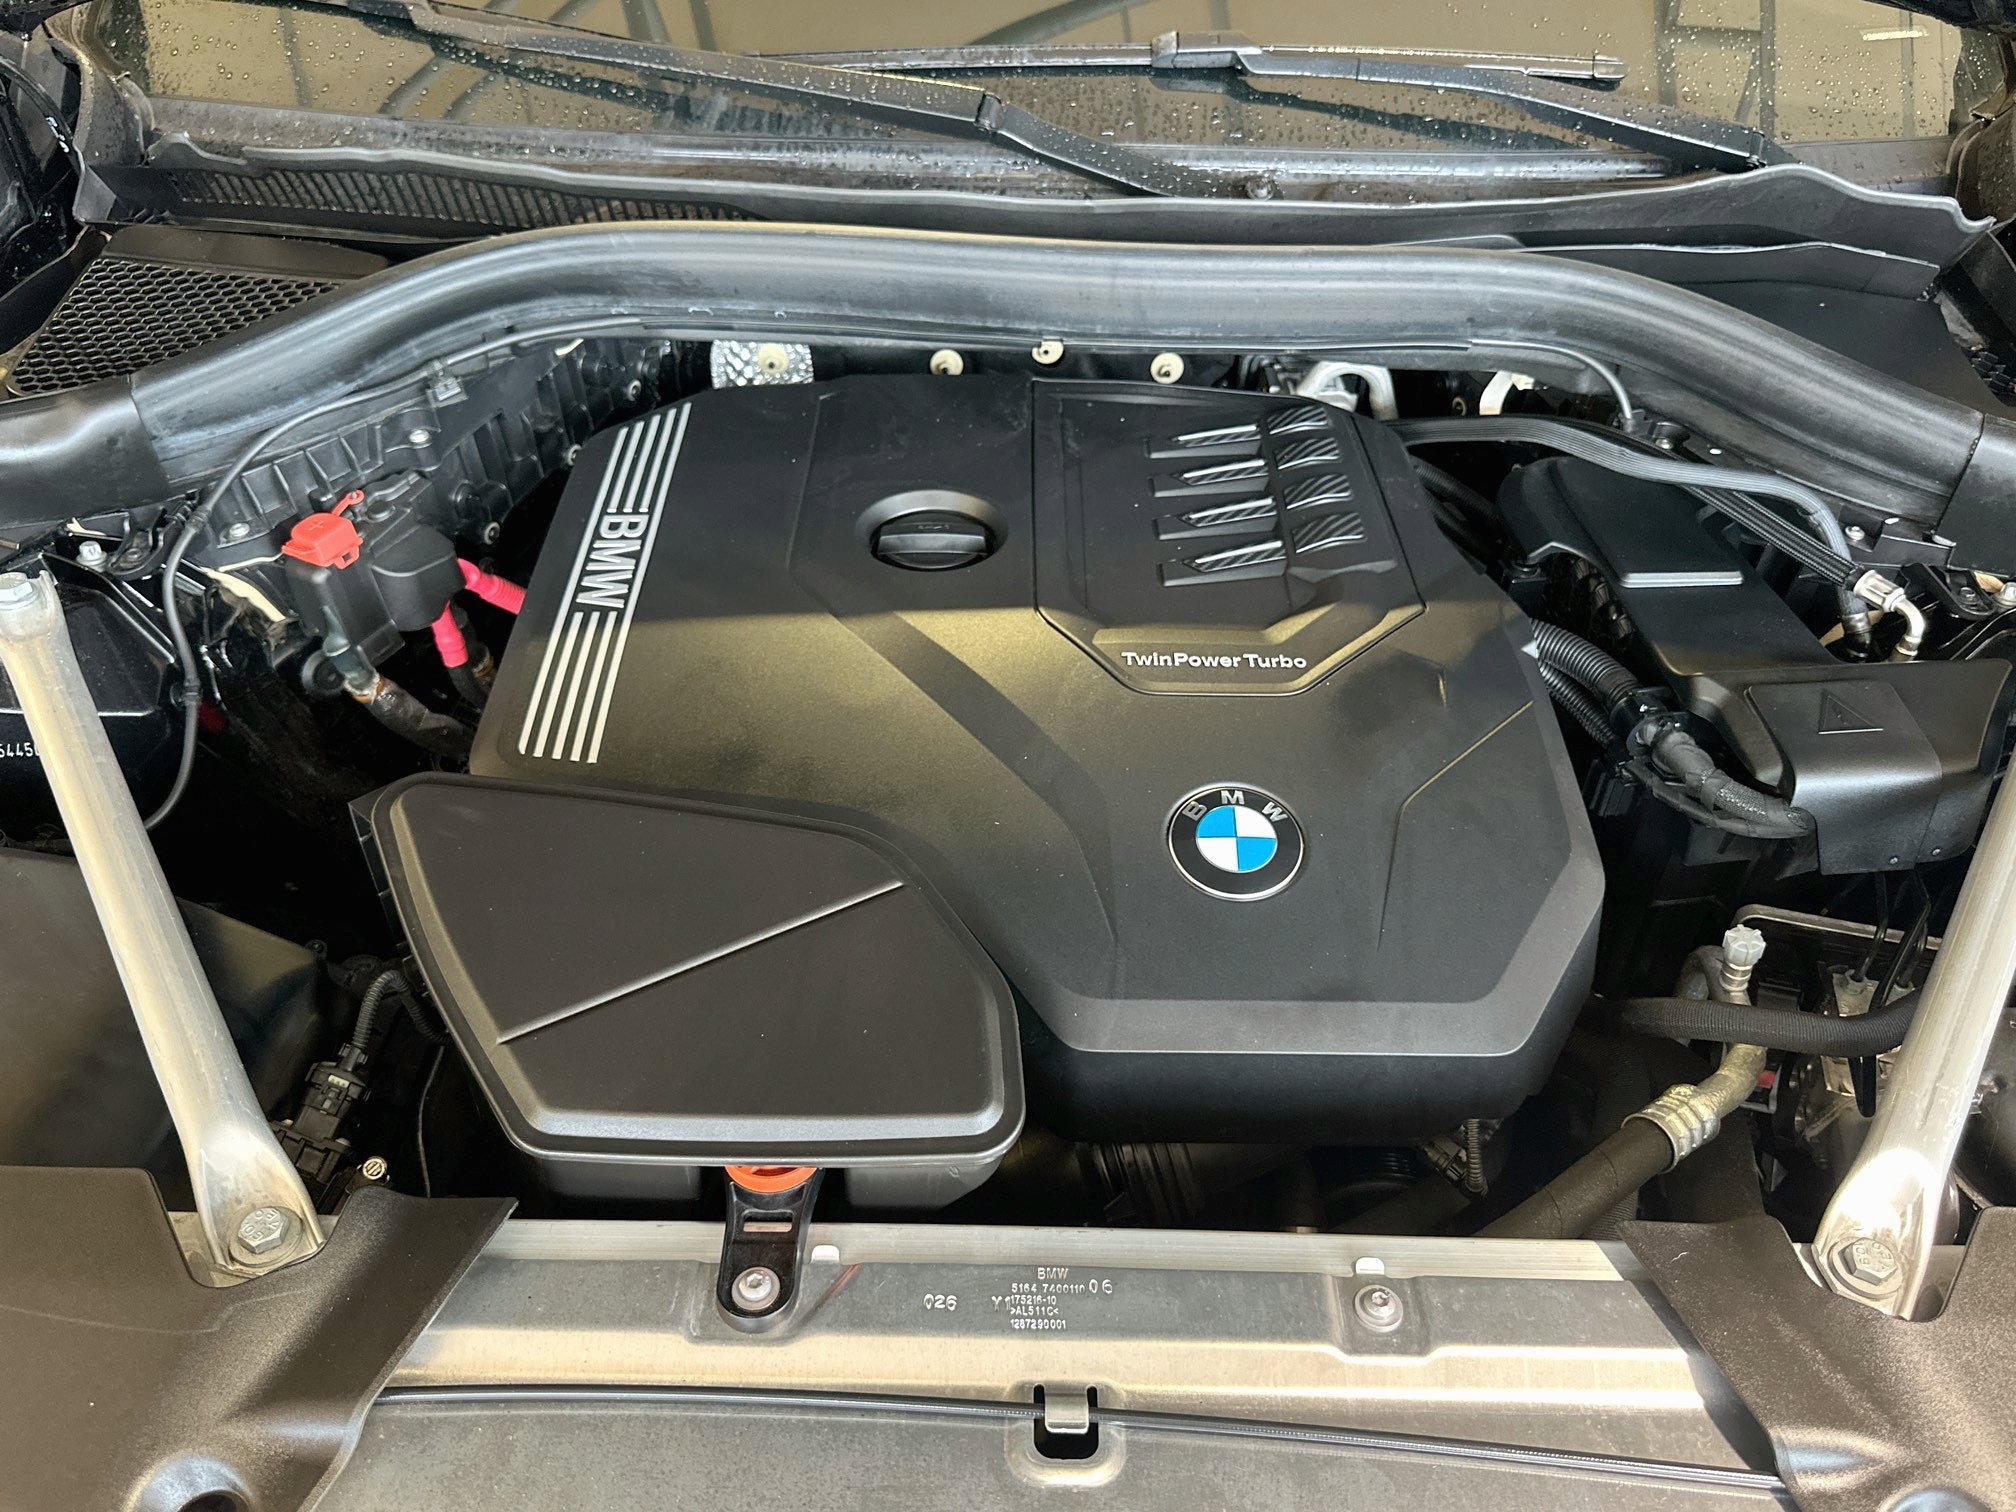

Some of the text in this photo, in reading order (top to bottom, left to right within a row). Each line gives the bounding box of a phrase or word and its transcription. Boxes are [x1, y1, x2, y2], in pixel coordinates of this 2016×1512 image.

[576, 514, 650, 609] BMW
[1243, 653, 1308, 668] Turbo
[1182, 790, 1288, 822] BMW
[1037, 1267, 1069, 1280] BMW
[1011, 1283, 1037, 1293] 5164
[923, 1294, 957, 1311] 026
